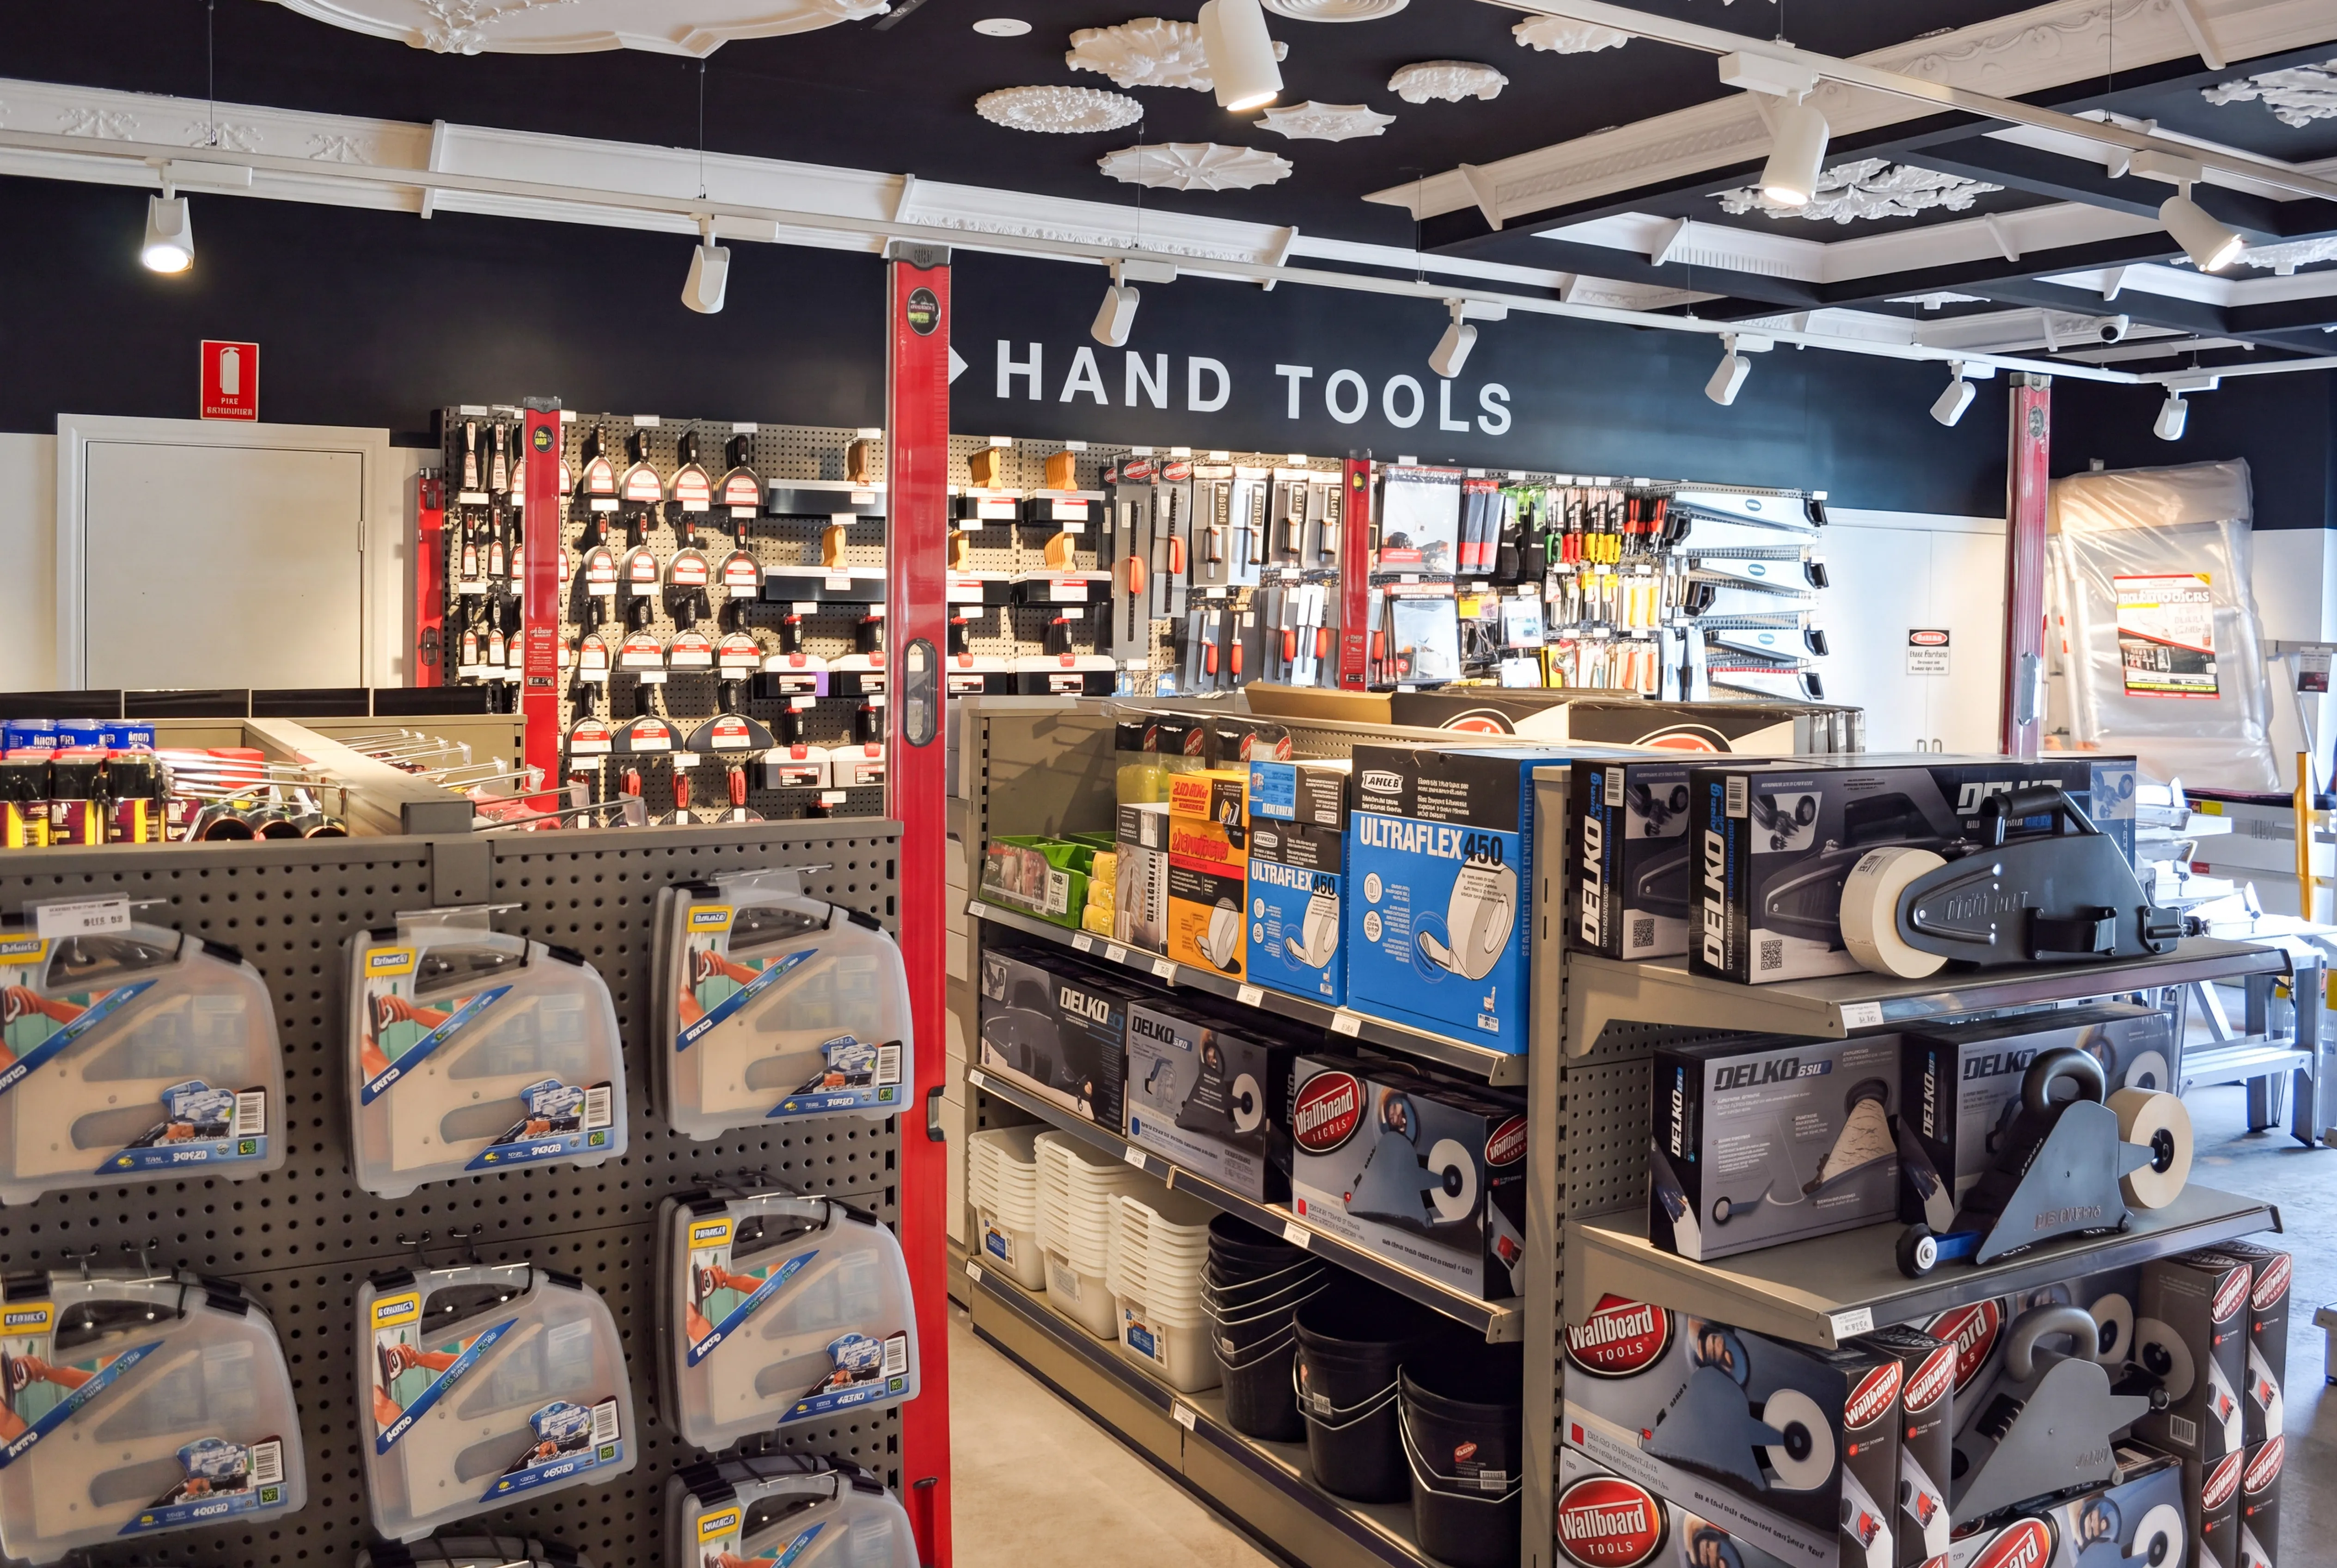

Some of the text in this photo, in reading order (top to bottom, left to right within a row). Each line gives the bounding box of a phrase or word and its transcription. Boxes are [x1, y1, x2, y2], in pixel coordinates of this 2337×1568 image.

[997, 339, 1512, 436] HAND TOOLS
[1360, 816, 1463, 860] ULTRAFLEX
[1463, 833, 1503, 867] 450
[1251, 860, 1313, 892] ULTRAFLEX
[1581, 815, 1603, 947] DELKO
[1703, 829, 1725, 970] DELKO
[1060, 986, 1109, 1024] DELKO
[1132, 1015, 1175, 1044] DELKO
[1713, 1057, 1799, 1091] DELKO
[1671, 1089, 1682, 1158] DELKO
[1923, 1072, 1935, 1139] DELKO
[1568, 1304, 1654, 1351] Wallboard
[1596, 1341, 1644, 1363] TOOLS
[1560, 1504, 1647, 1541] Wallboard
[1588, 1541, 1633, 1556] TOOLS
